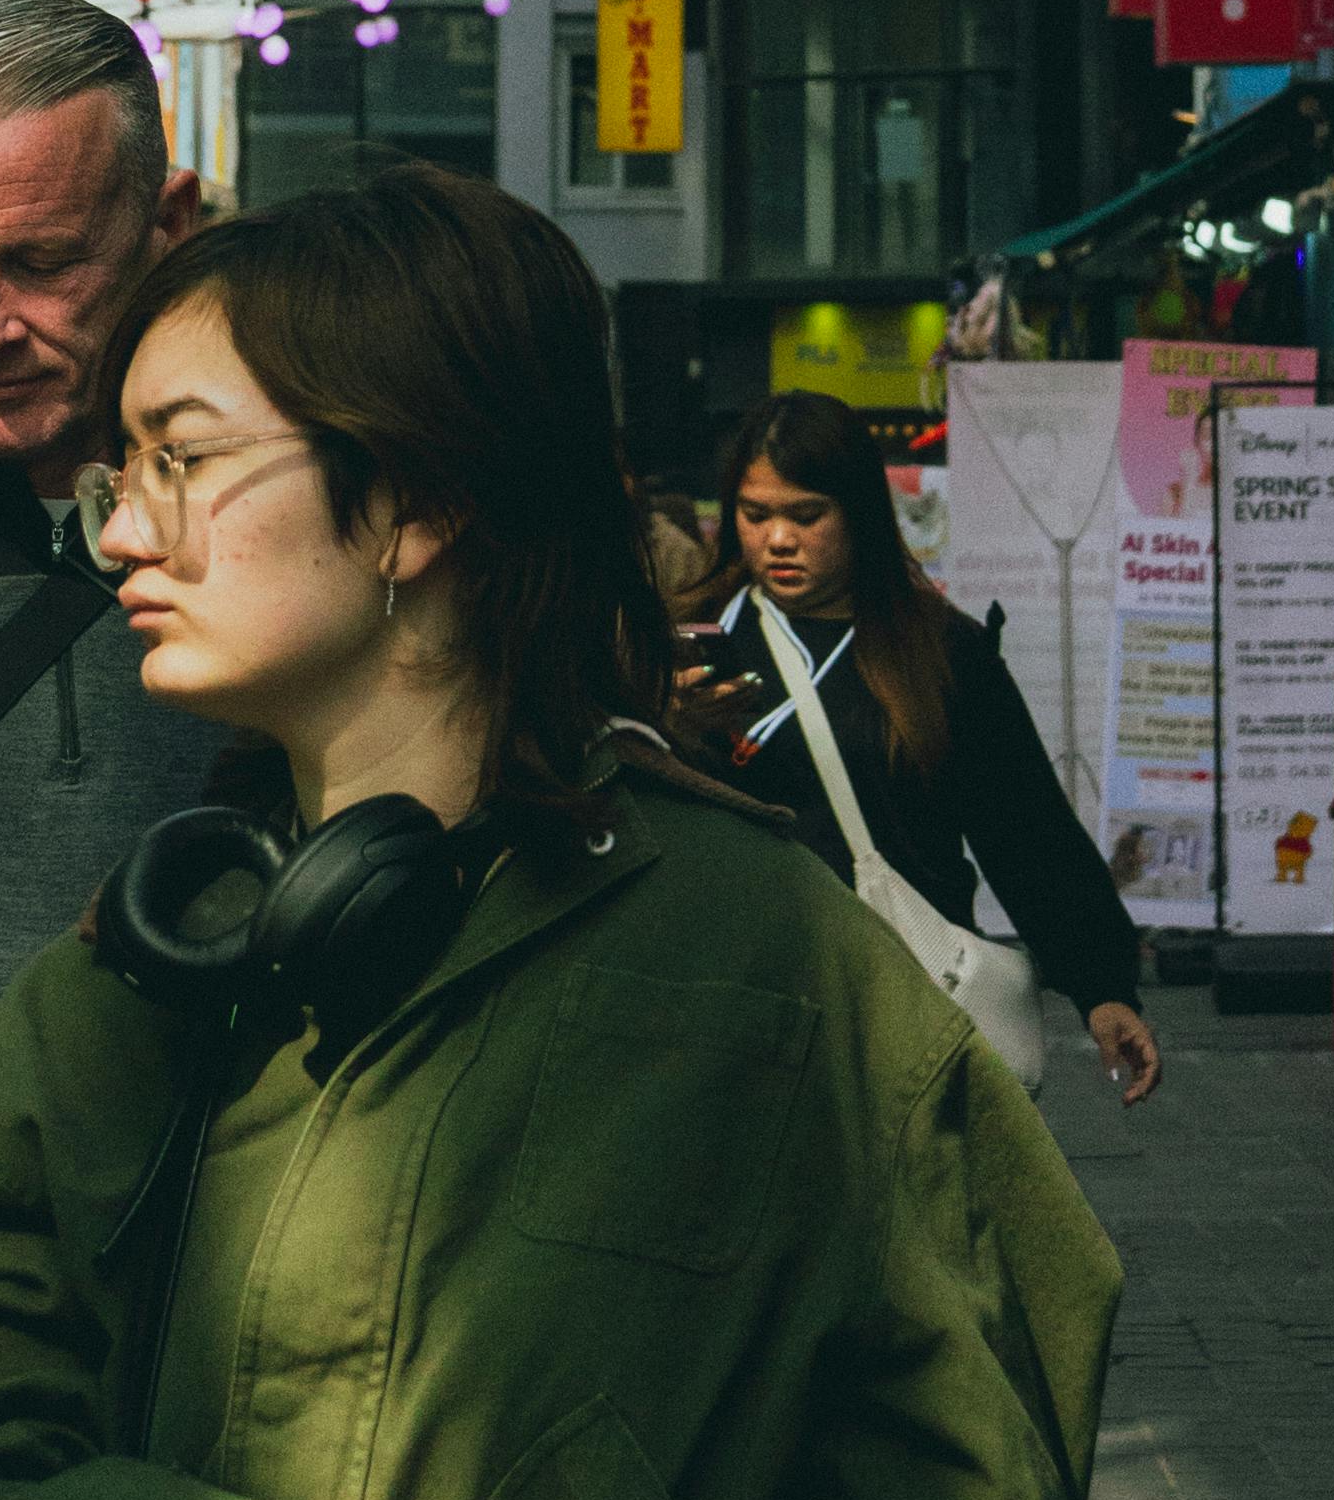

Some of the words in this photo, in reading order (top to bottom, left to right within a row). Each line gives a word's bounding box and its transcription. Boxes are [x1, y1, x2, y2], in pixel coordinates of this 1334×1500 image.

[1233, 475, 1321, 498] SPRING
[1234, 500, 1310, 521] EVENT
[1151, 532, 1201, 555] Skin
[1124, 559, 1207, 584] Special
